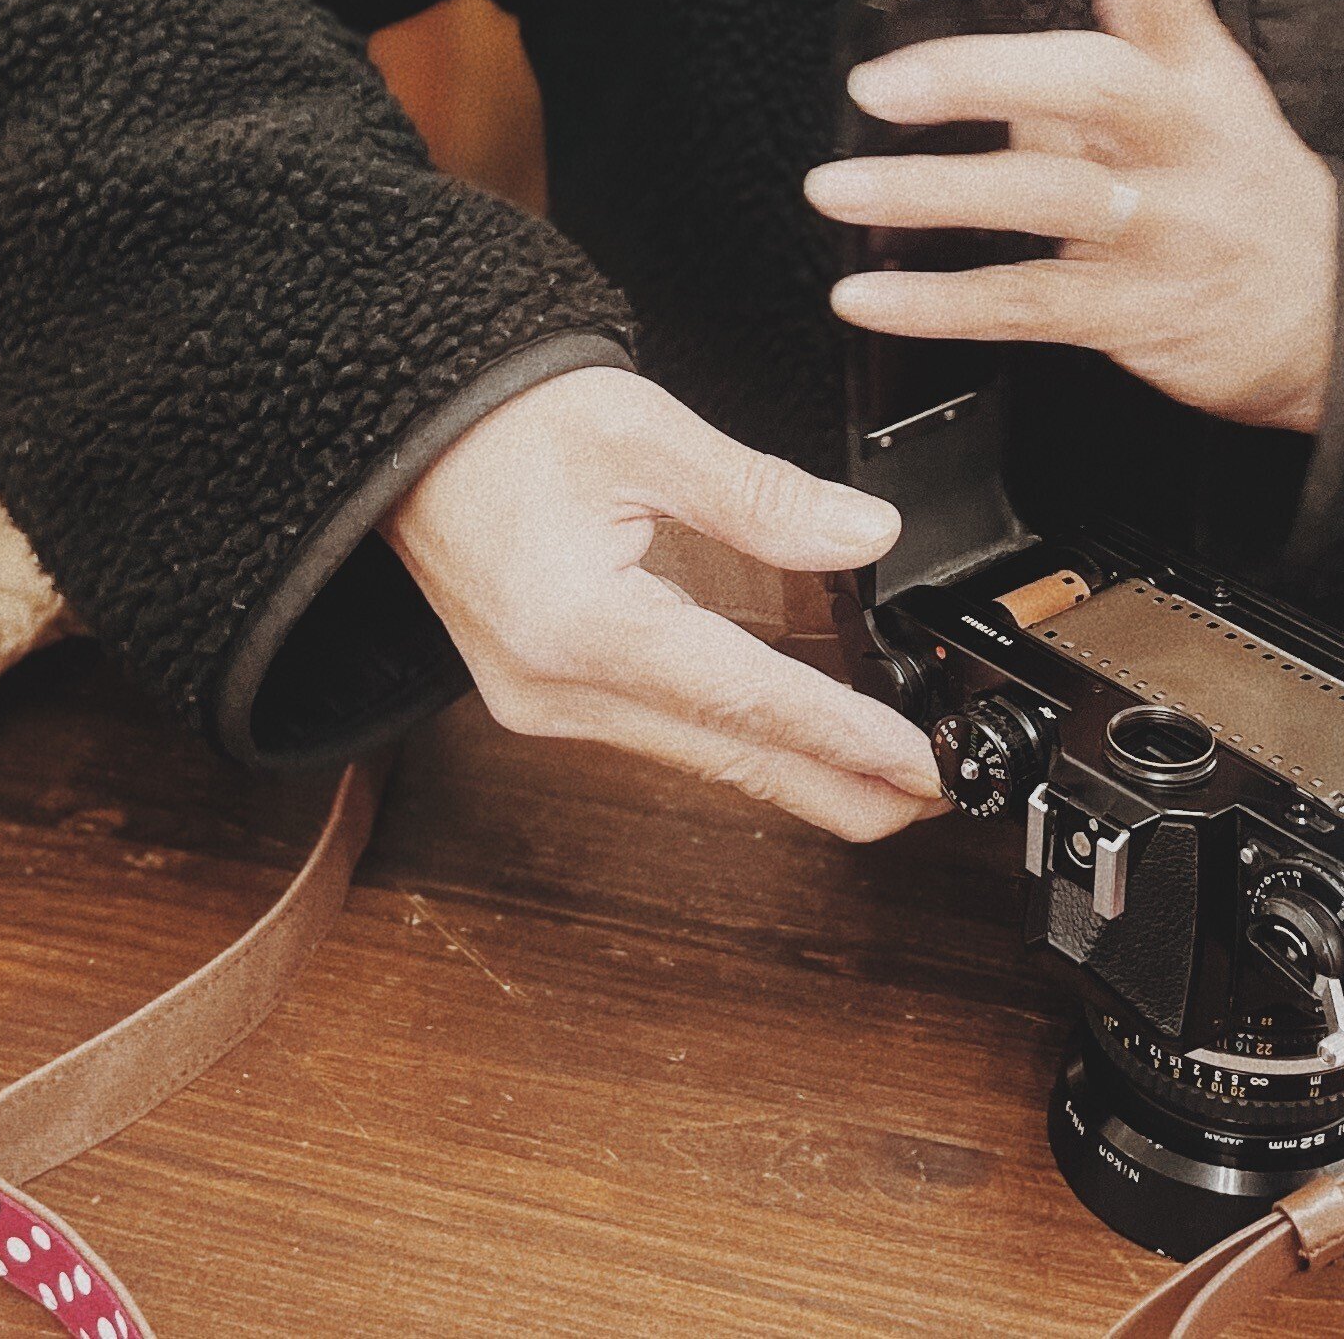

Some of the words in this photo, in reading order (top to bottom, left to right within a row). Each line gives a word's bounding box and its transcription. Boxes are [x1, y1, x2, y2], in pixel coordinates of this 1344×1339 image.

[988, 767, 1006, 779] 250
[1236, 1041, 1251, 1054] 16
[1256, 1043, 1273, 1056] 22
[1193, 1064, 1201, 1076] 2
[1214, 1070, 1222, 1082] 3
[1197, 1077, 1203, 1088] 7
[1231, 1074, 1239, 1086] 5
[1309, 1075, 1322, 1086] m
[1211, 1081, 1224, 1094] 10
[1230, 1086, 1246, 1098] 20
[1204, 1131, 1244, 1146] JAPAN
[1268, 1133, 1326, 1151] 52mm
[1098, 1144, 1140, 1183] Nikon
